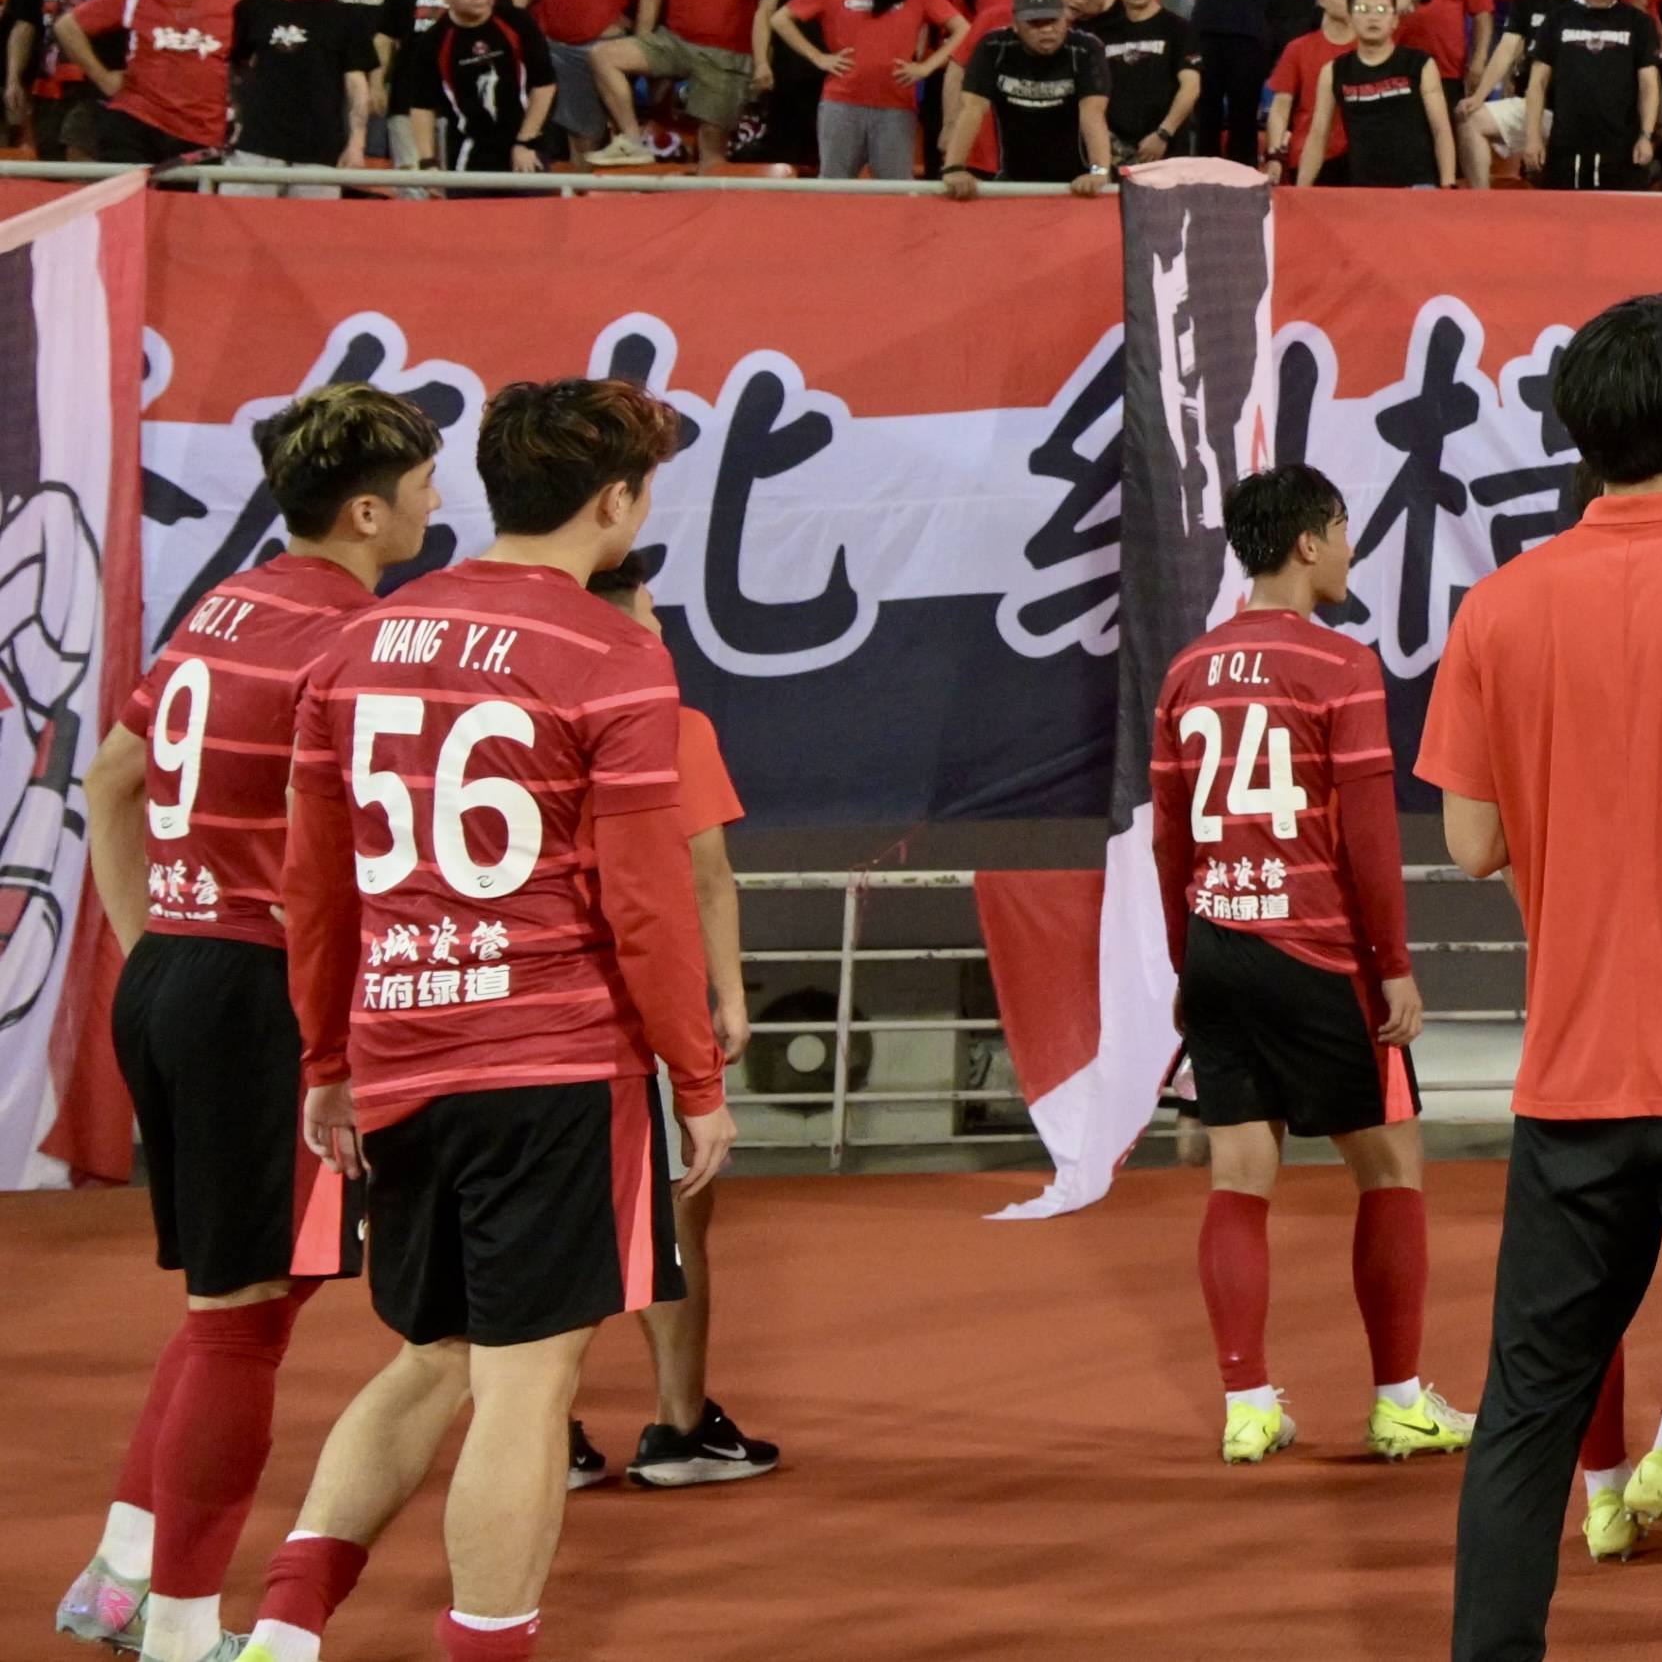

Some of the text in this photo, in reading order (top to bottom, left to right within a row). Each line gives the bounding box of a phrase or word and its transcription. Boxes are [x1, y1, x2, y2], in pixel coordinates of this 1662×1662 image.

[371, 619, 518, 674] WANG Y.H.
[1229, 651, 1270, 684] Q.L.
[149, 657, 210, 840] 9
[351, 693, 542, 899] 56
[1179, 702, 1307, 843] 24
[1194, 889, 1289, 921] 天府绿道
